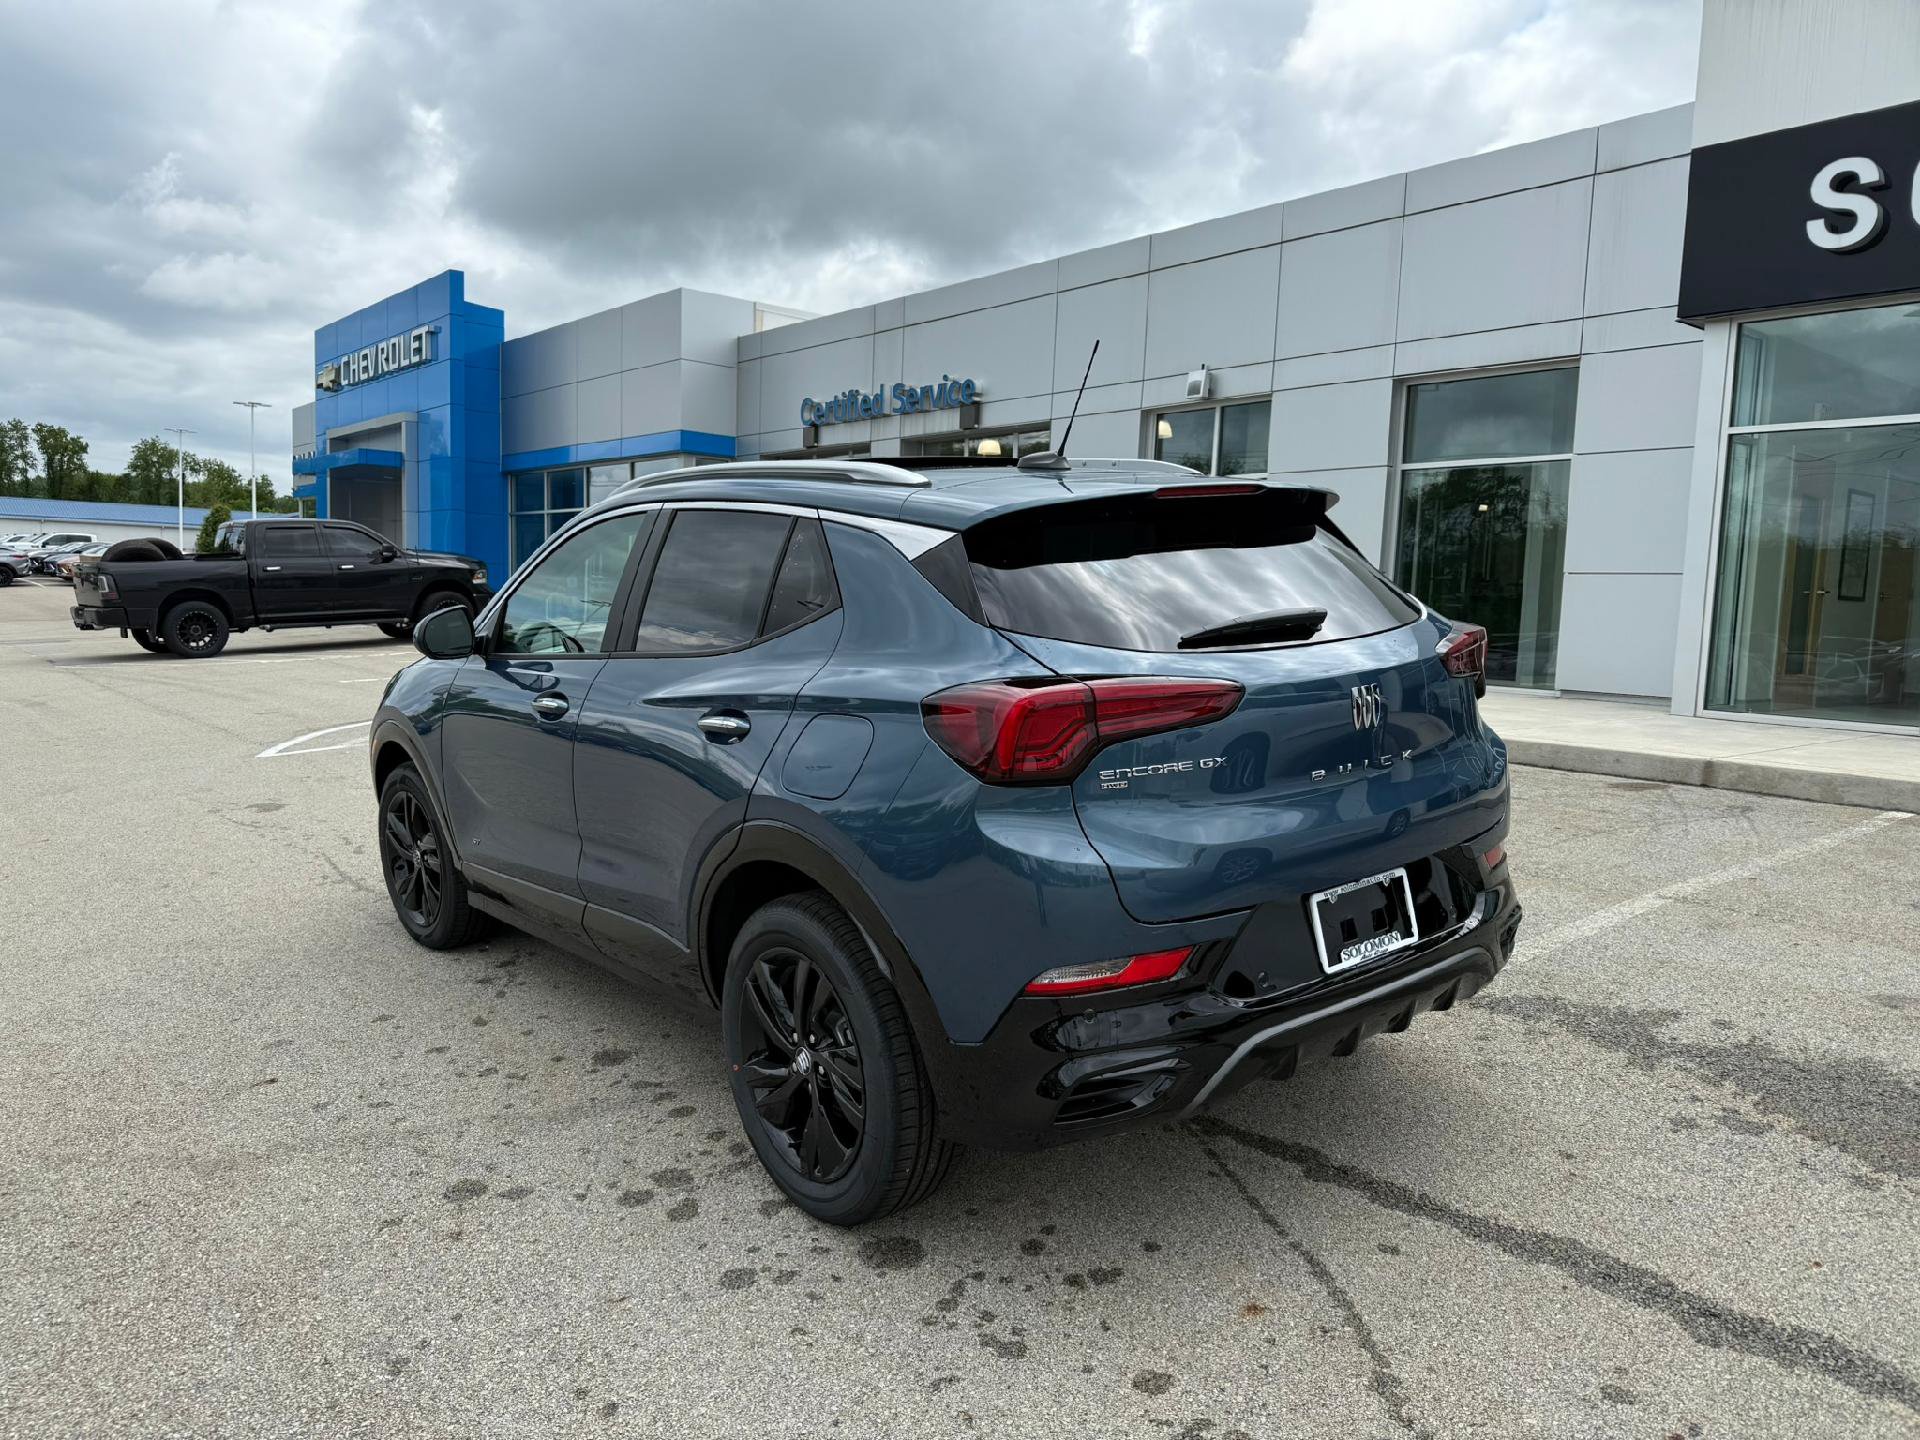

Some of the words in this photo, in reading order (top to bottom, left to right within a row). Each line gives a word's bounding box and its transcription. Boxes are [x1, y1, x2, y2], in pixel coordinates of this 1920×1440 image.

[1806, 156, 1920, 250] S
[340, 325, 436, 386] CHEVROLET
[800, 383, 885, 427] Certified
[891, 374, 977, 414] Service
[1099, 760, 1194, 780] ENCORE
[1199, 756, 1228, 769] GX
[1311, 748, 1413, 783] BUICK
[1342, 931, 1401, 961] SOLOMON
